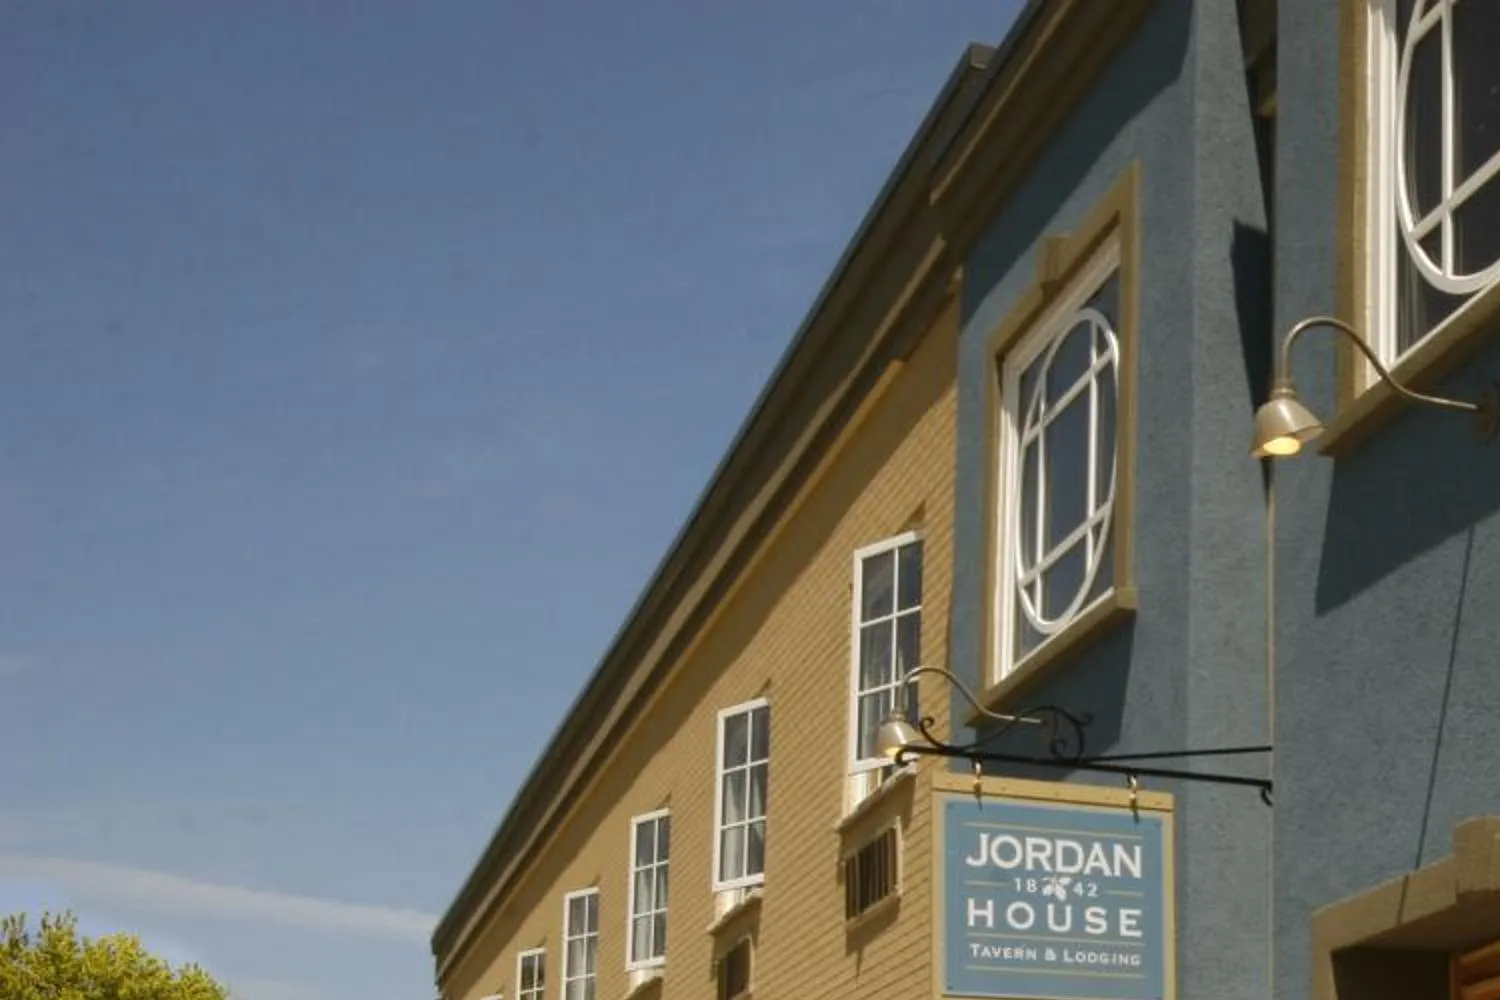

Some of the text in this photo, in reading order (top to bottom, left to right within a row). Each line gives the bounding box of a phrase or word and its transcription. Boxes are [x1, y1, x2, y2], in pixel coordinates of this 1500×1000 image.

[966, 832, 1143, 878] JORDAN
[967, 898, 1143, 938] HOUSE
[970, 943, 1142, 966] TAVERN & LODGING
